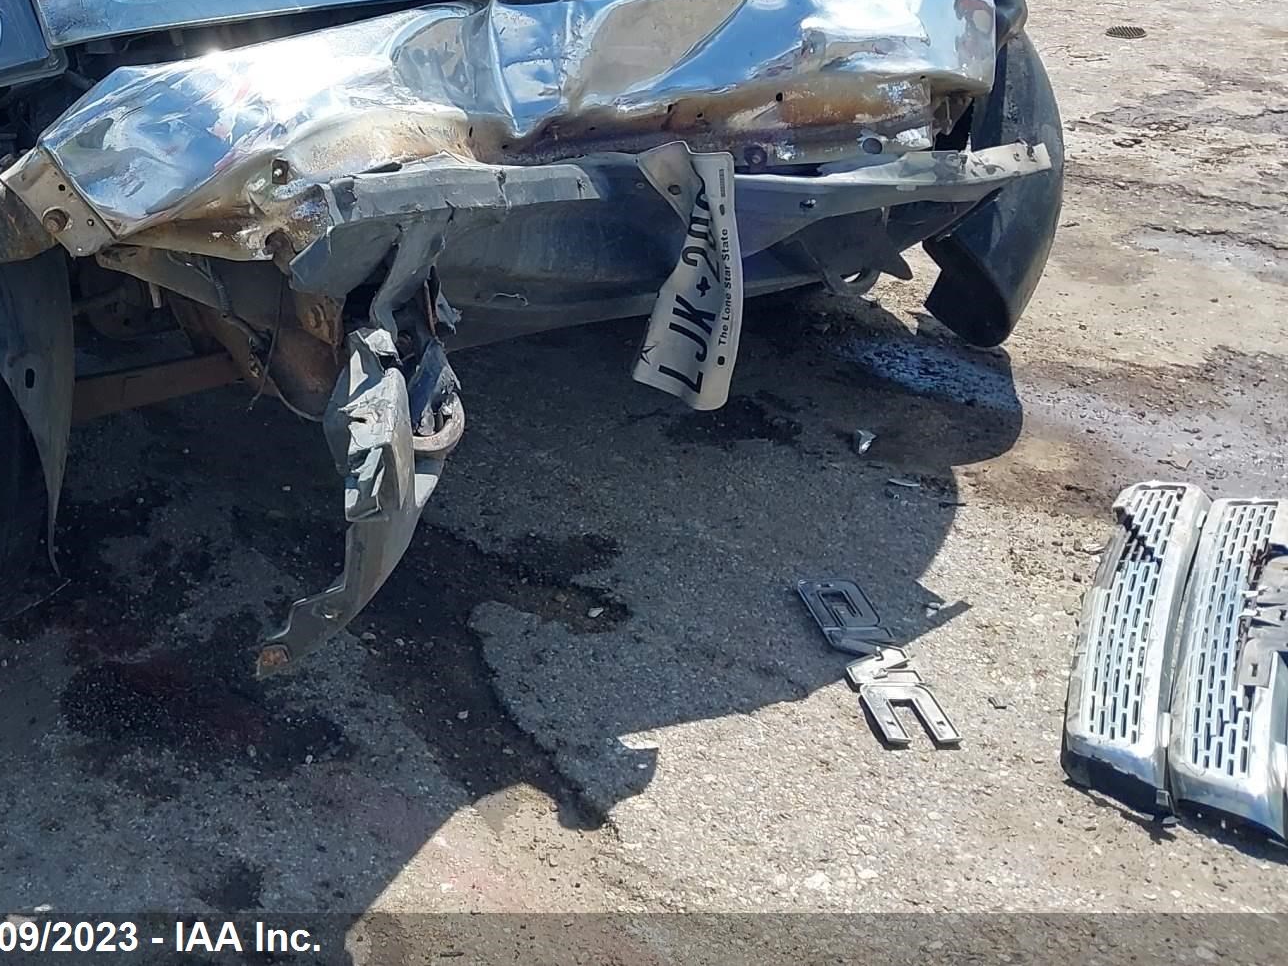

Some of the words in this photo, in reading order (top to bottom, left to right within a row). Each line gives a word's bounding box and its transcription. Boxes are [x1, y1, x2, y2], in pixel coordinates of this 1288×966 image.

[721, 228, 729, 261] State
[724, 263, 732, 290] Star
[723, 293, 732, 325] Lone
[659, 294, 717, 394] LJK
[718, 326, 729, 346] The
